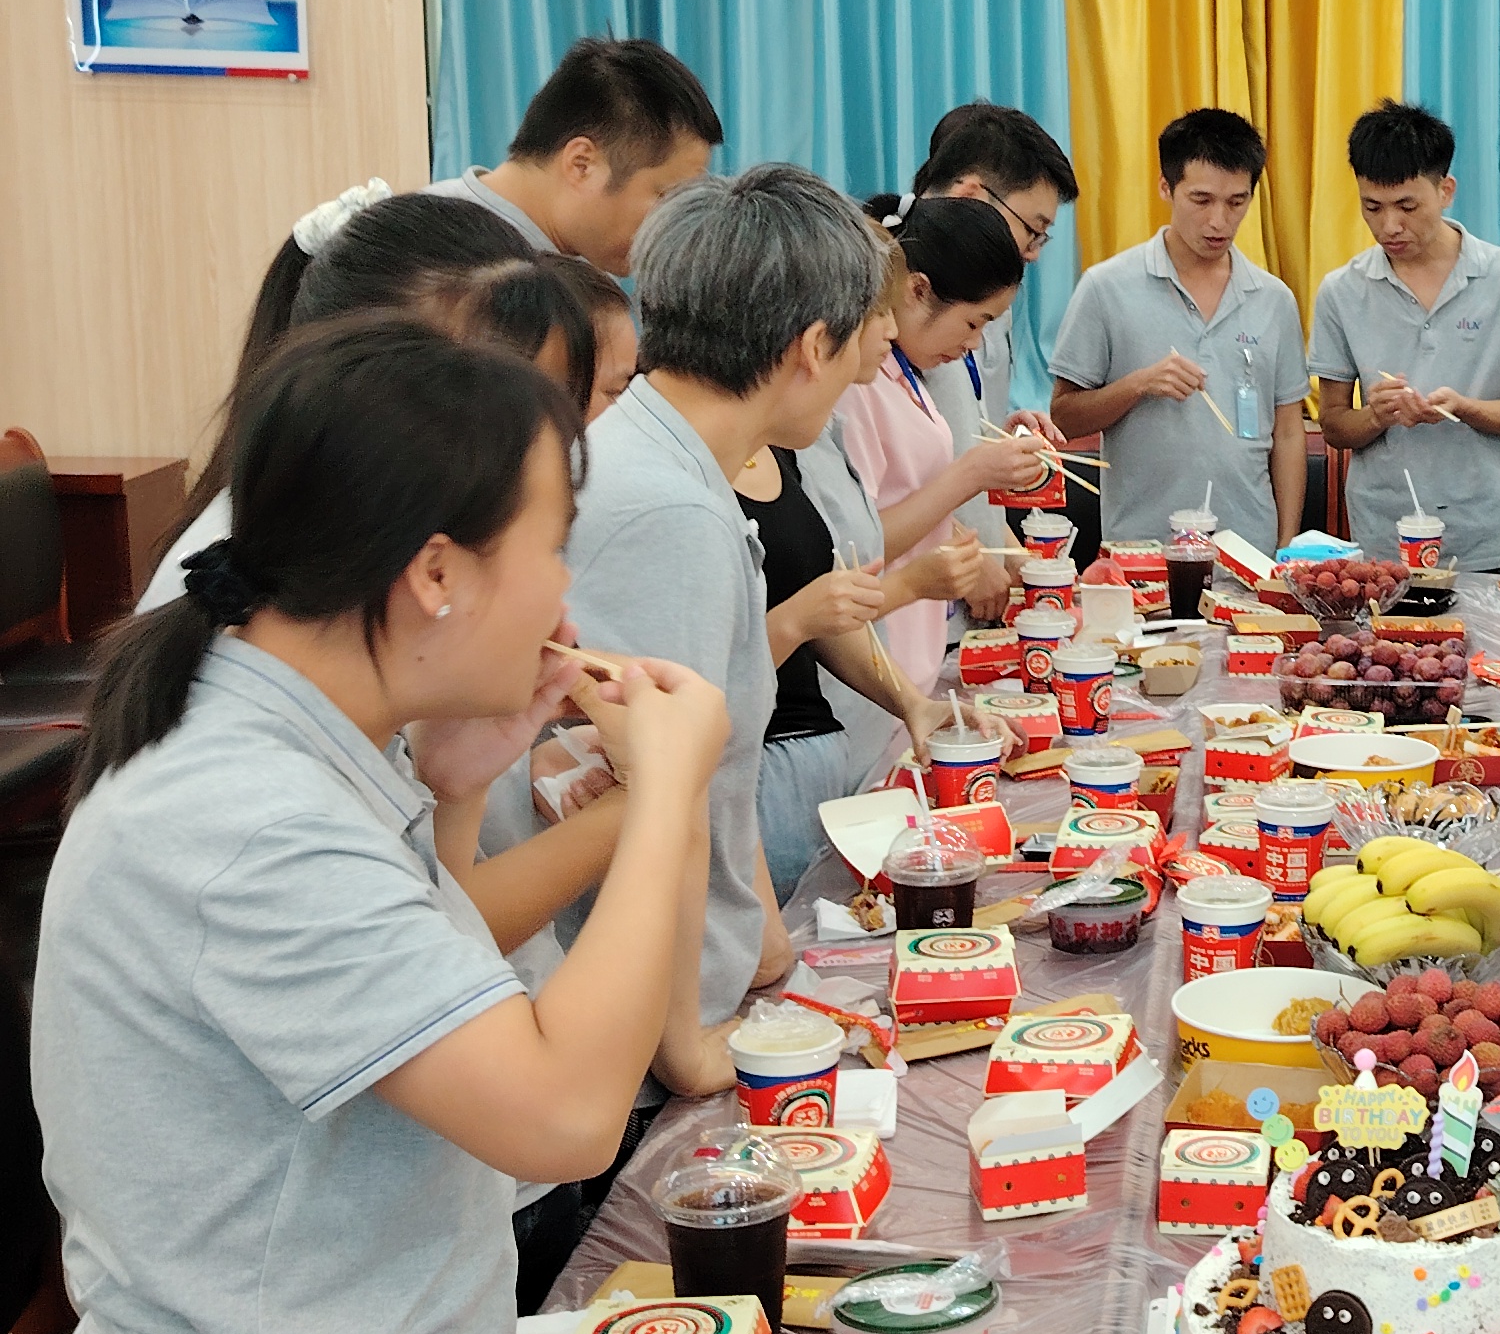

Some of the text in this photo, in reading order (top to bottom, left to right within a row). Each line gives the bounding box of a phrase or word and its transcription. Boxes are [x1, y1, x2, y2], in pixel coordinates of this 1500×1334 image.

[1343, 1088, 1396, 1106] HAPPY
[1319, 1107, 1423, 1126] BIRTHDAY
[1341, 1127, 1400, 1142] TO YOU
